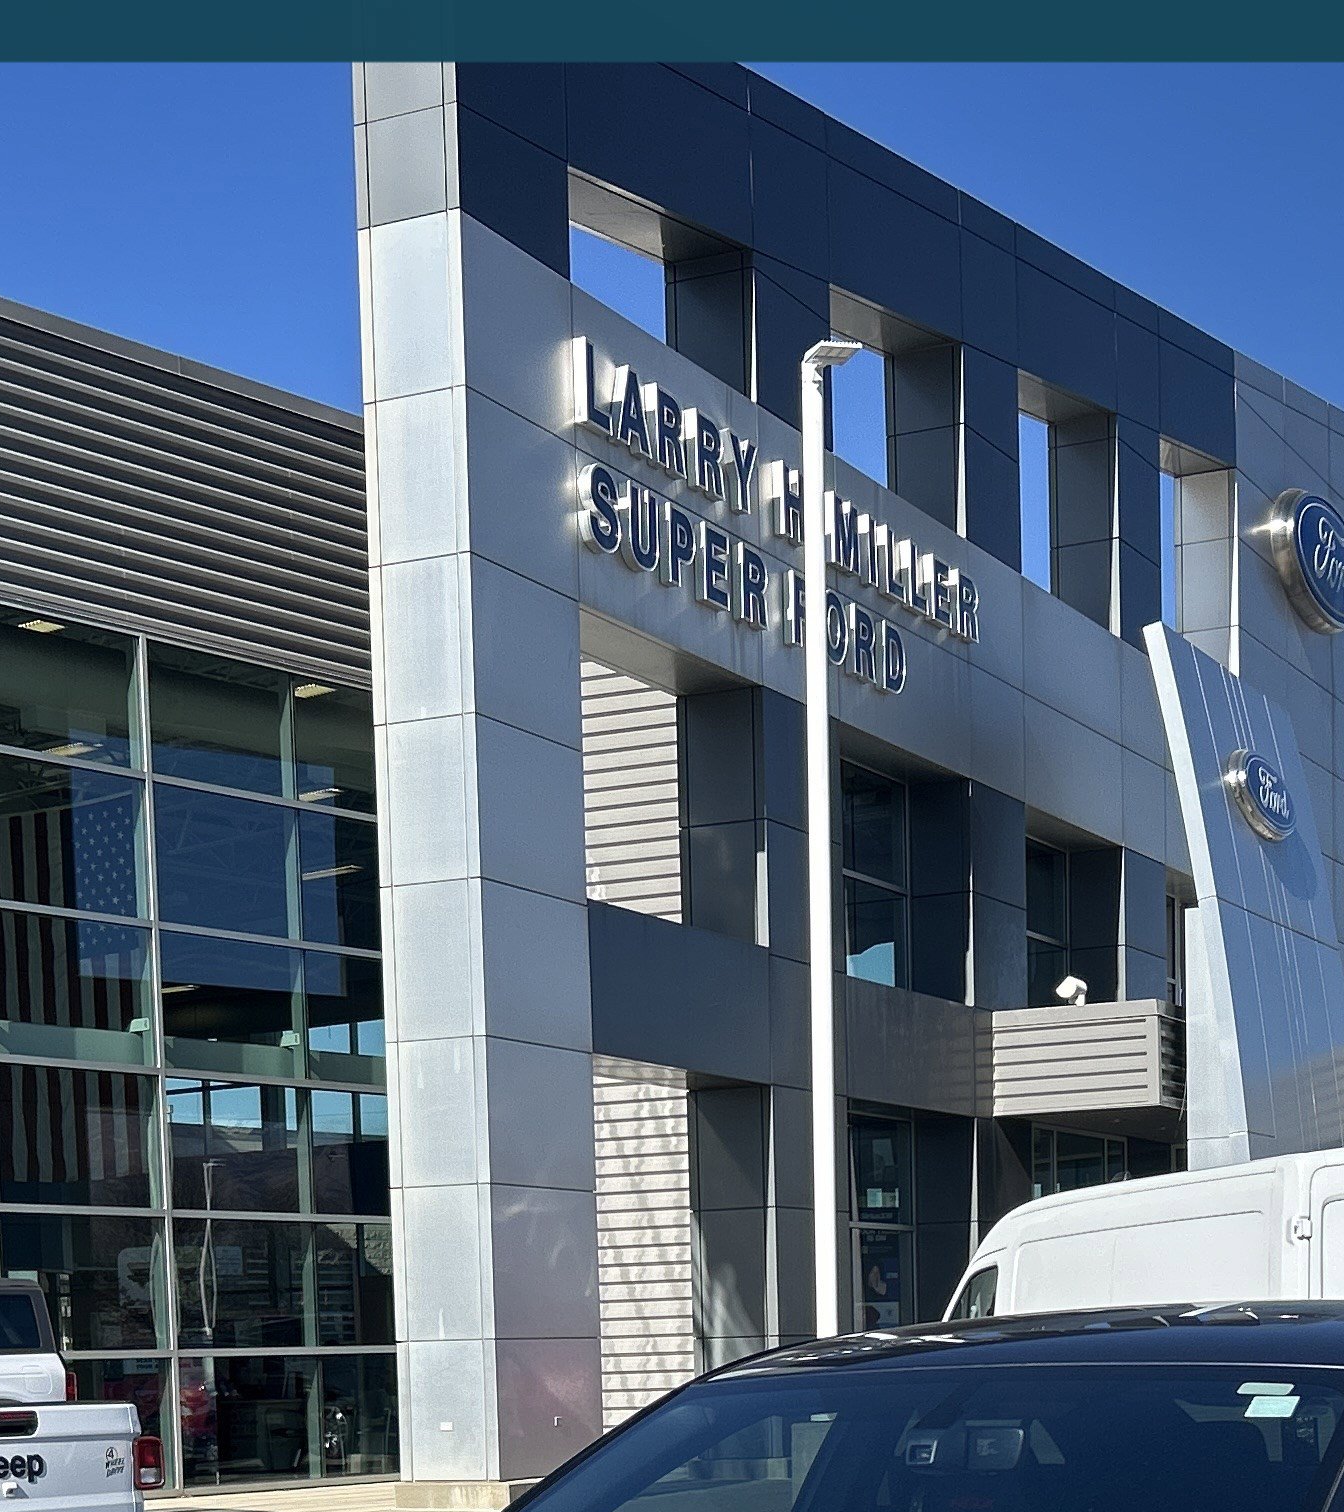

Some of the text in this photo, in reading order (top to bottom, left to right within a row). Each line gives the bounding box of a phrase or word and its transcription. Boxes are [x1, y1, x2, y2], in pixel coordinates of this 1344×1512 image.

[573, 336, 981, 643] LARRY H MILLER
[578, 463, 907, 694] SUPER FORD
[1259, 766, 1290, 819] Ford
